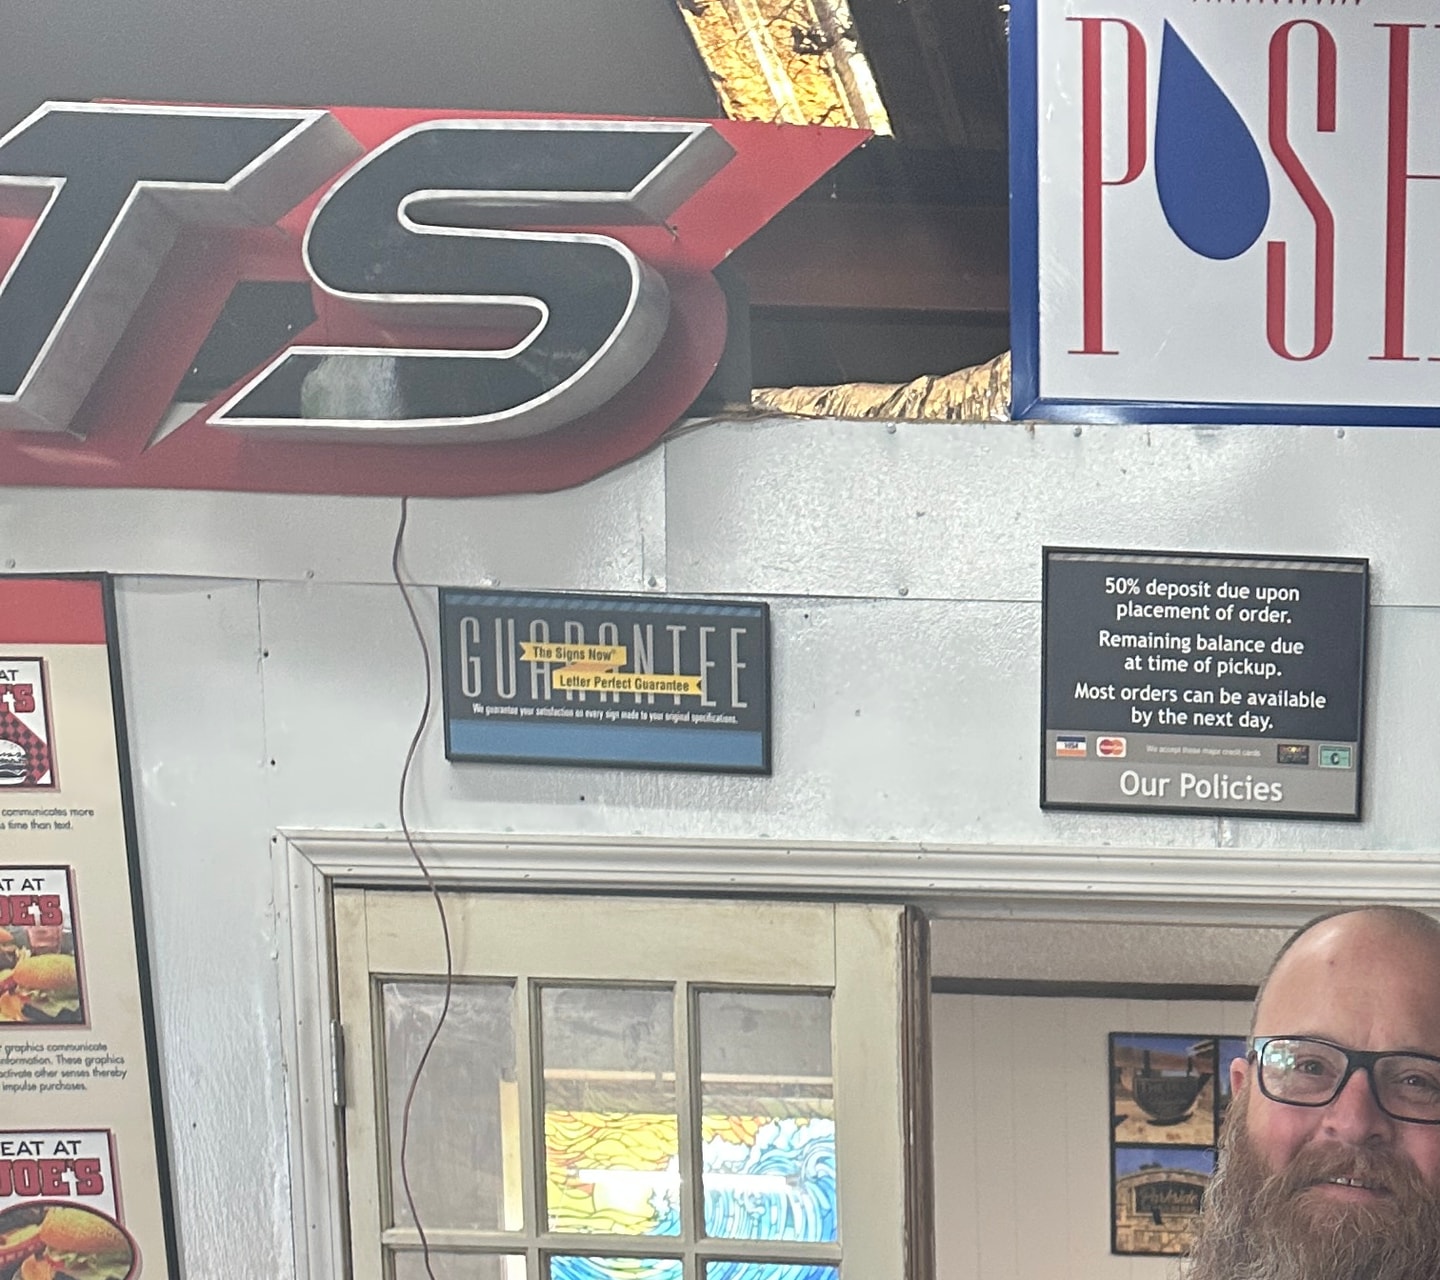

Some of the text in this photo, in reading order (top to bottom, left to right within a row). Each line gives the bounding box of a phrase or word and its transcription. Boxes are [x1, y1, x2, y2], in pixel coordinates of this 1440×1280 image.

[1105, 577, 1300, 604] 50% deposit due upon
[1116, 601, 1291, 624] placement of order.
[533, 646, 550, 659] The
[555, 646, 585, 661] Signs
[1099, 630, 1304, 655] Remaining balance due
[1124, 655, 1282, 679] at time of pickup.
[559, 675, 690, 692] Letter Perfect Guarantee
[1074, 682, 1327, 709] Most orders can be available
[1131, 706, 1273, 731] by the next day.
[1120, 770, 1283, 801] Our Policies
[20, 878, 45, 891] AT
[1, 1140, 81, 1156] EAT AT
